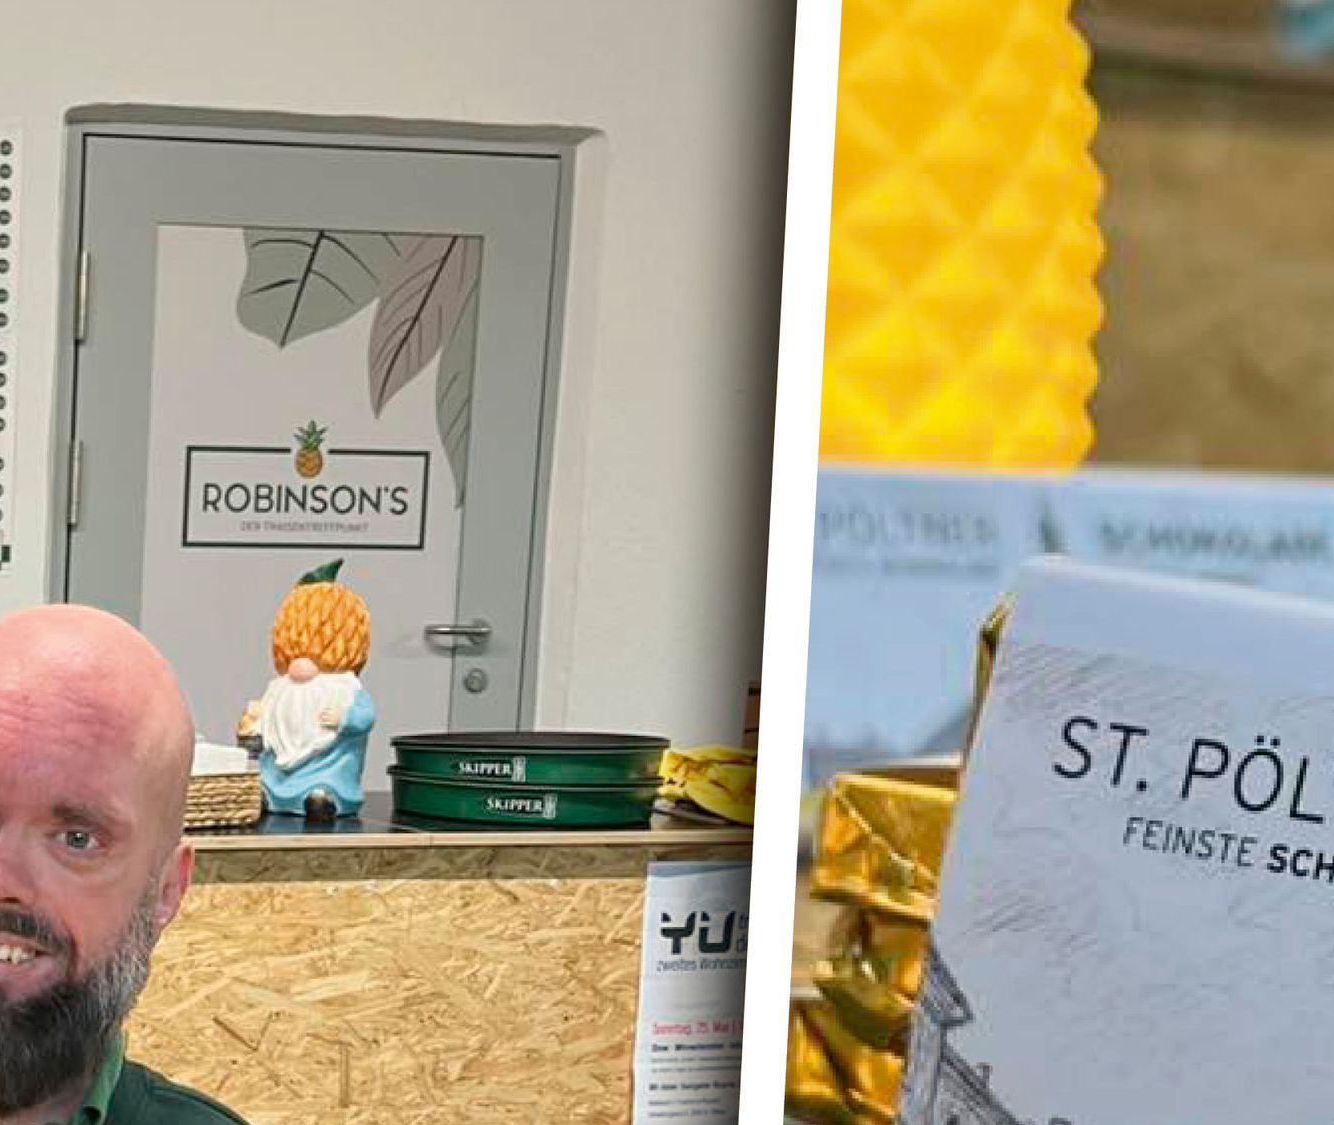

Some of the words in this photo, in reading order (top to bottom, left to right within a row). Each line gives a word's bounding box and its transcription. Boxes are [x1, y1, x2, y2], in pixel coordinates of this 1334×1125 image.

[202, 482, 409, 516] ROBINSON'S
[458, 760, 513, 776] SKIPPER
[1052, 714, 1149, 792] ST.
[486, 796, 544, 813] SKIPPER
[1122, 815, 1259, 869] FEINSTE
